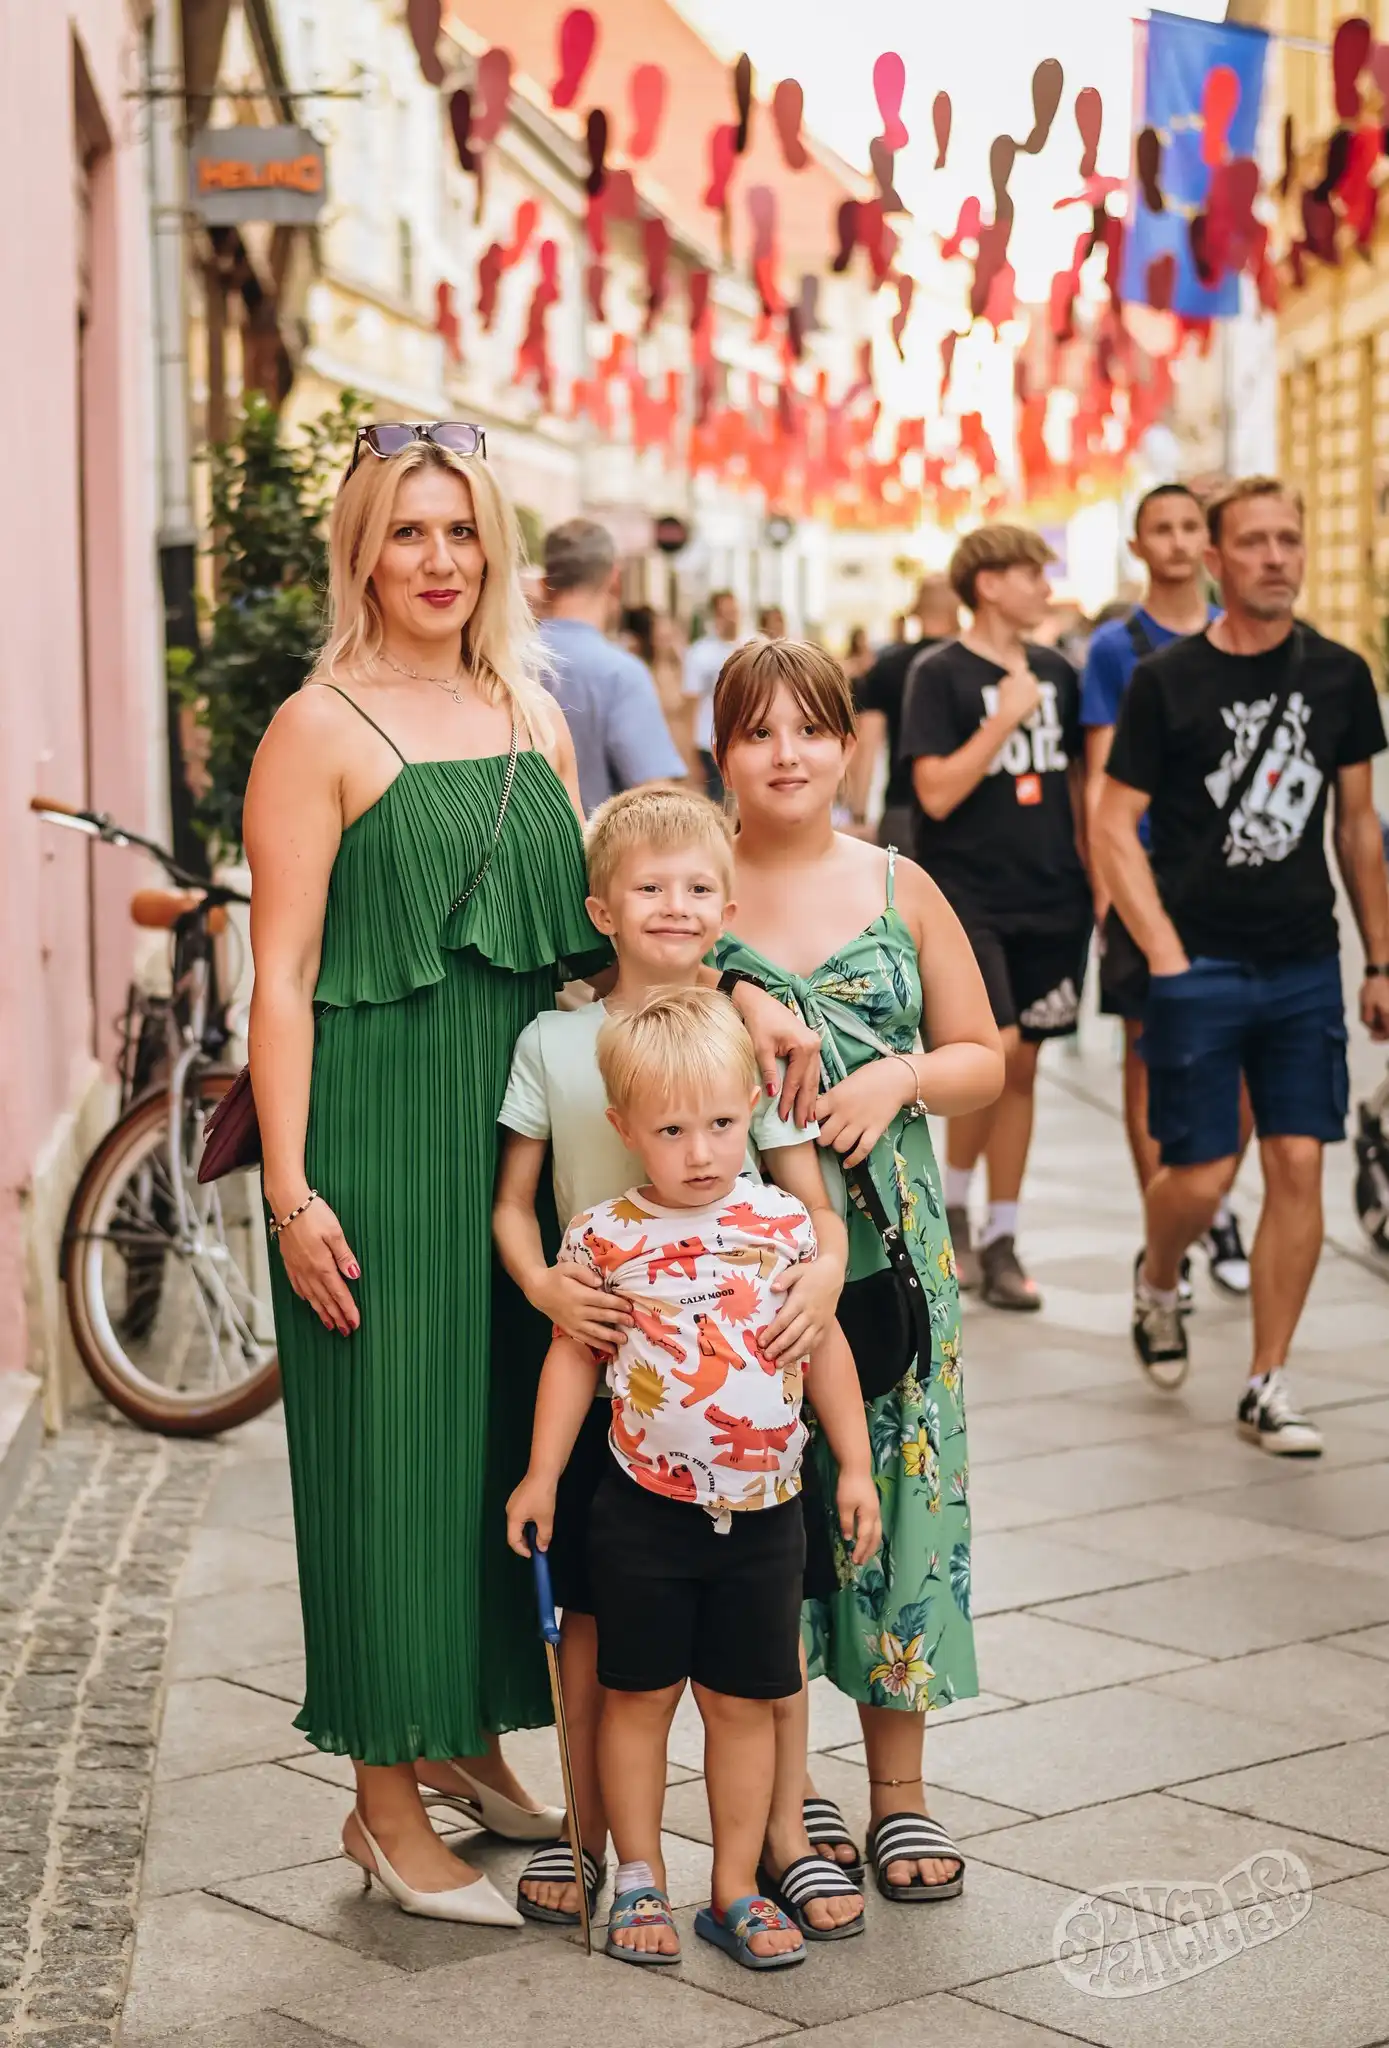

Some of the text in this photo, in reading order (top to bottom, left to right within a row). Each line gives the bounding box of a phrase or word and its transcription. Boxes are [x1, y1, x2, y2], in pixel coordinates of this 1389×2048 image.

[680, 1288, 735, 1304] CALM MOOD
[668, 1451, 716, 1493] FEEL THE VIBE
